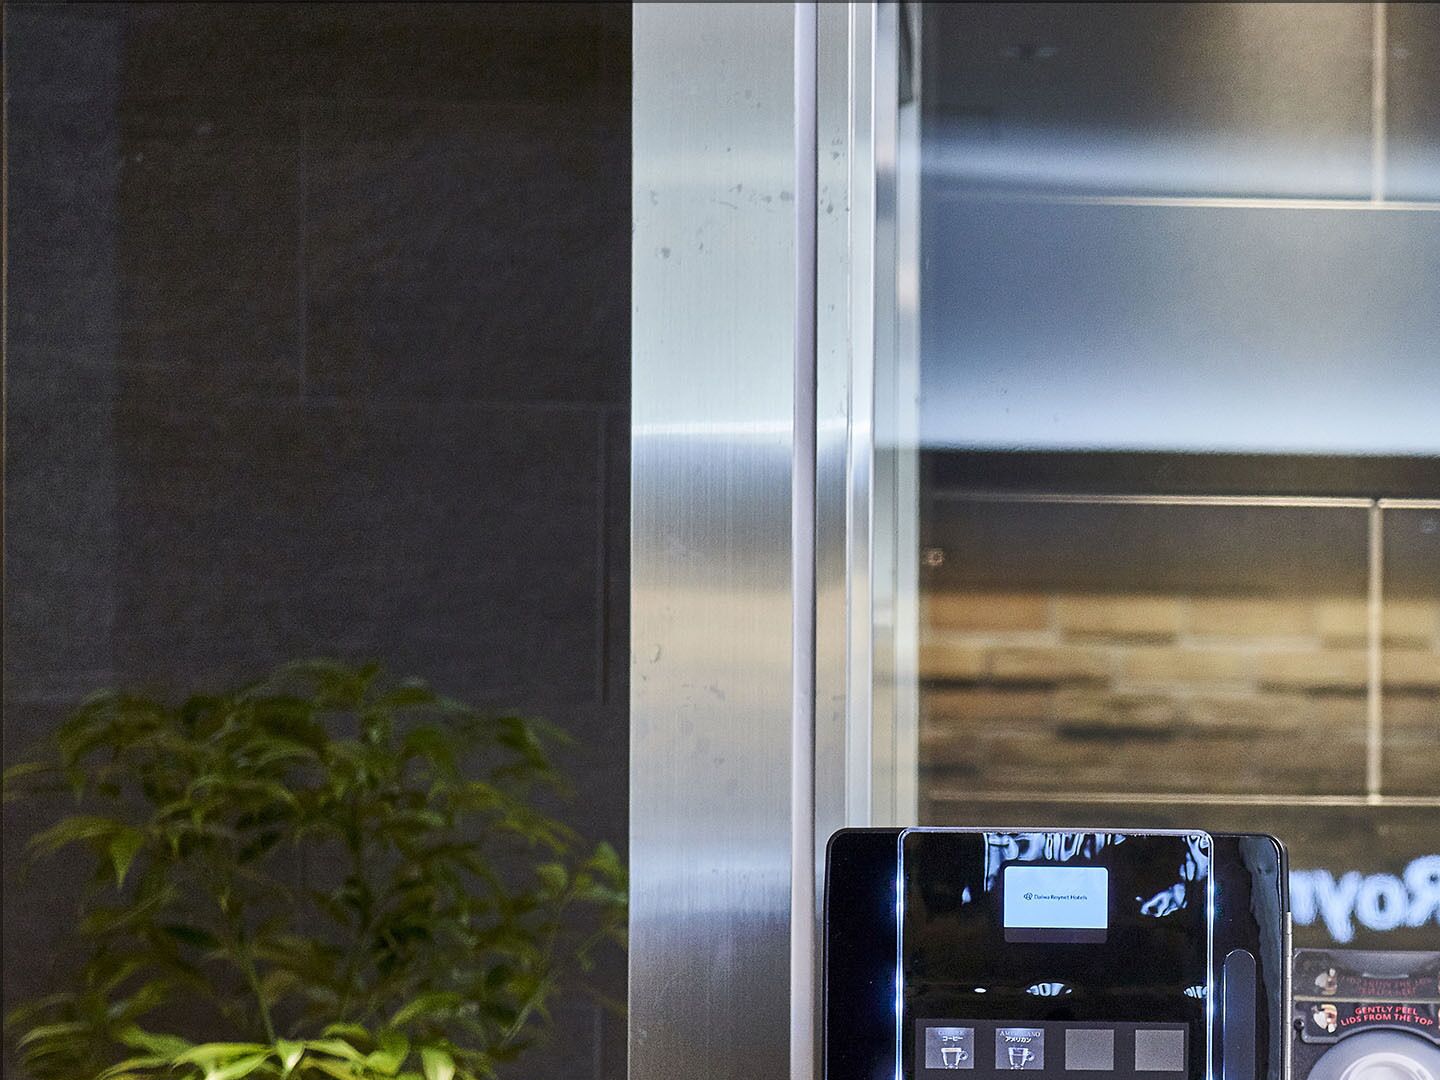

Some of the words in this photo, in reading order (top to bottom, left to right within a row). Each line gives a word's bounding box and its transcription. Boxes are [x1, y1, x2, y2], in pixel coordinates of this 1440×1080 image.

[1354, 1006, 1394, 1015] GENTLY
[1395, 1006, 1418, 1015] PEEL
[1340, 1016, 1362, 1026] LIDS
[1394, 1014, 1412, 1022] THE
[1414, 1016, 1434, 1026] TOP
